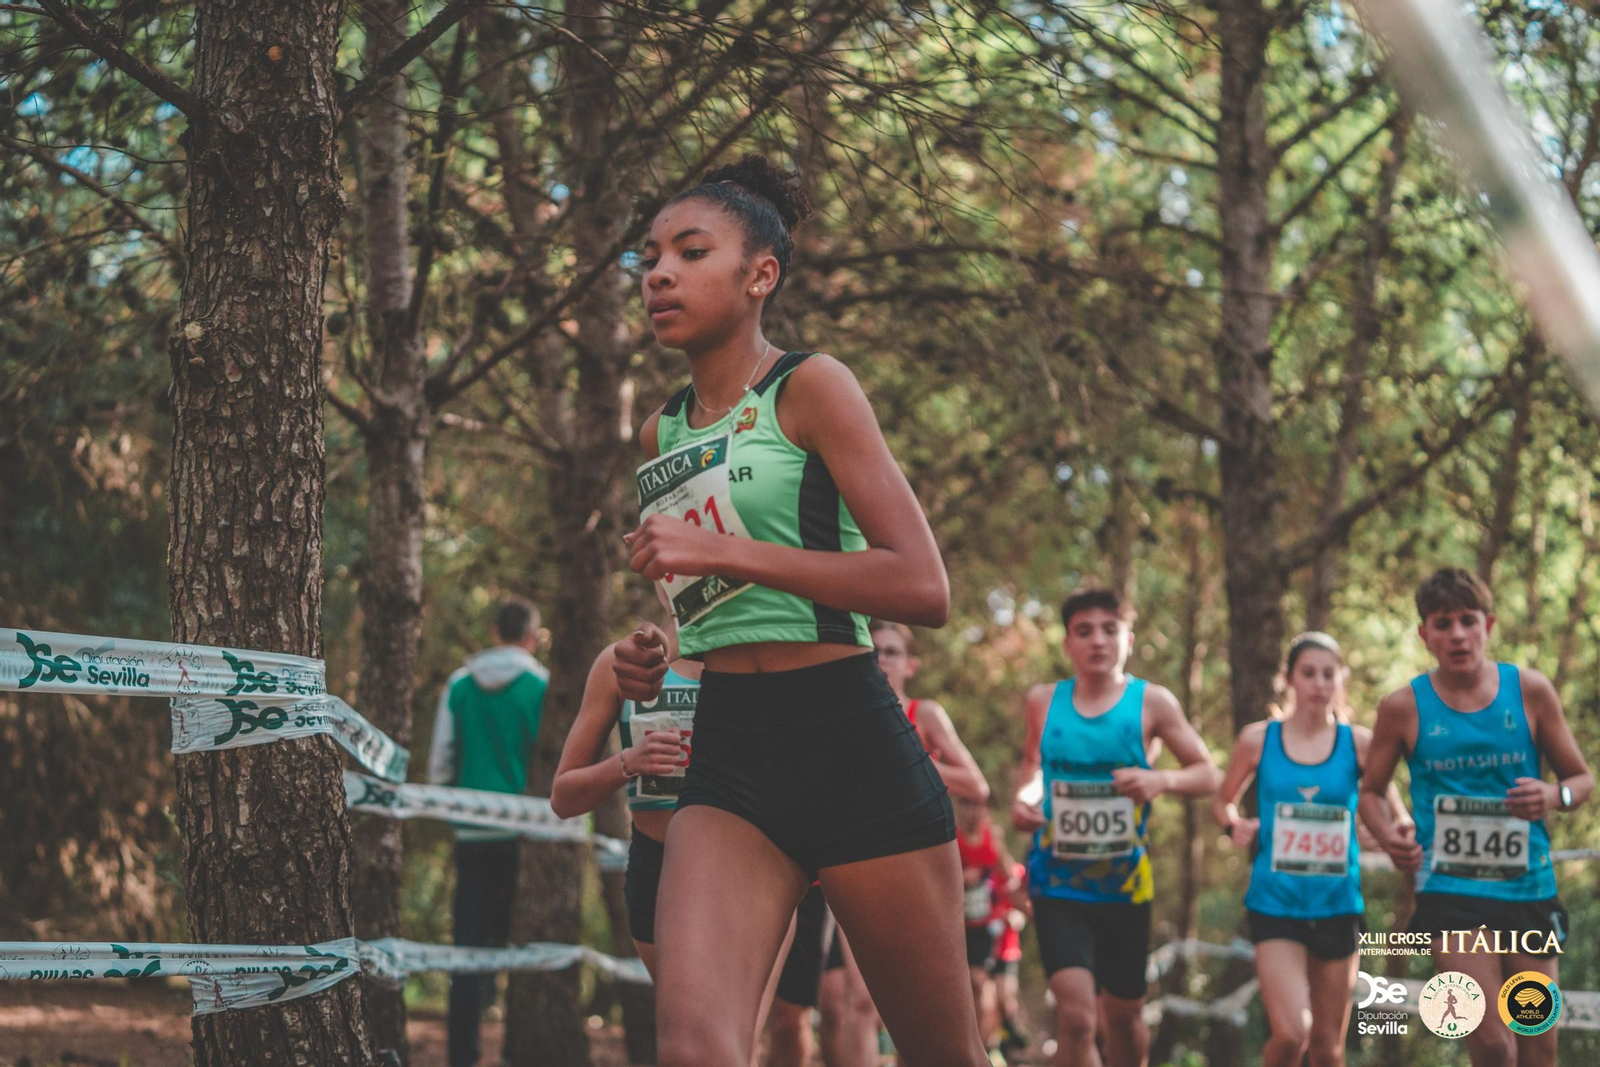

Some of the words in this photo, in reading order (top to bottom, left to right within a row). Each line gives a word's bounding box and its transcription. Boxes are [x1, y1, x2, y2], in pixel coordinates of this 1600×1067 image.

[639, 452, 693, 496] ITÁLICA
[81, 651, 145, 667] Diputación
[87, 665, 150, 688] Sevilla
[1059, 809, 1128, 835] 6005
[1282, 828, 1346, 858] 7450
[1443, 827, 1523, 858] 8146
